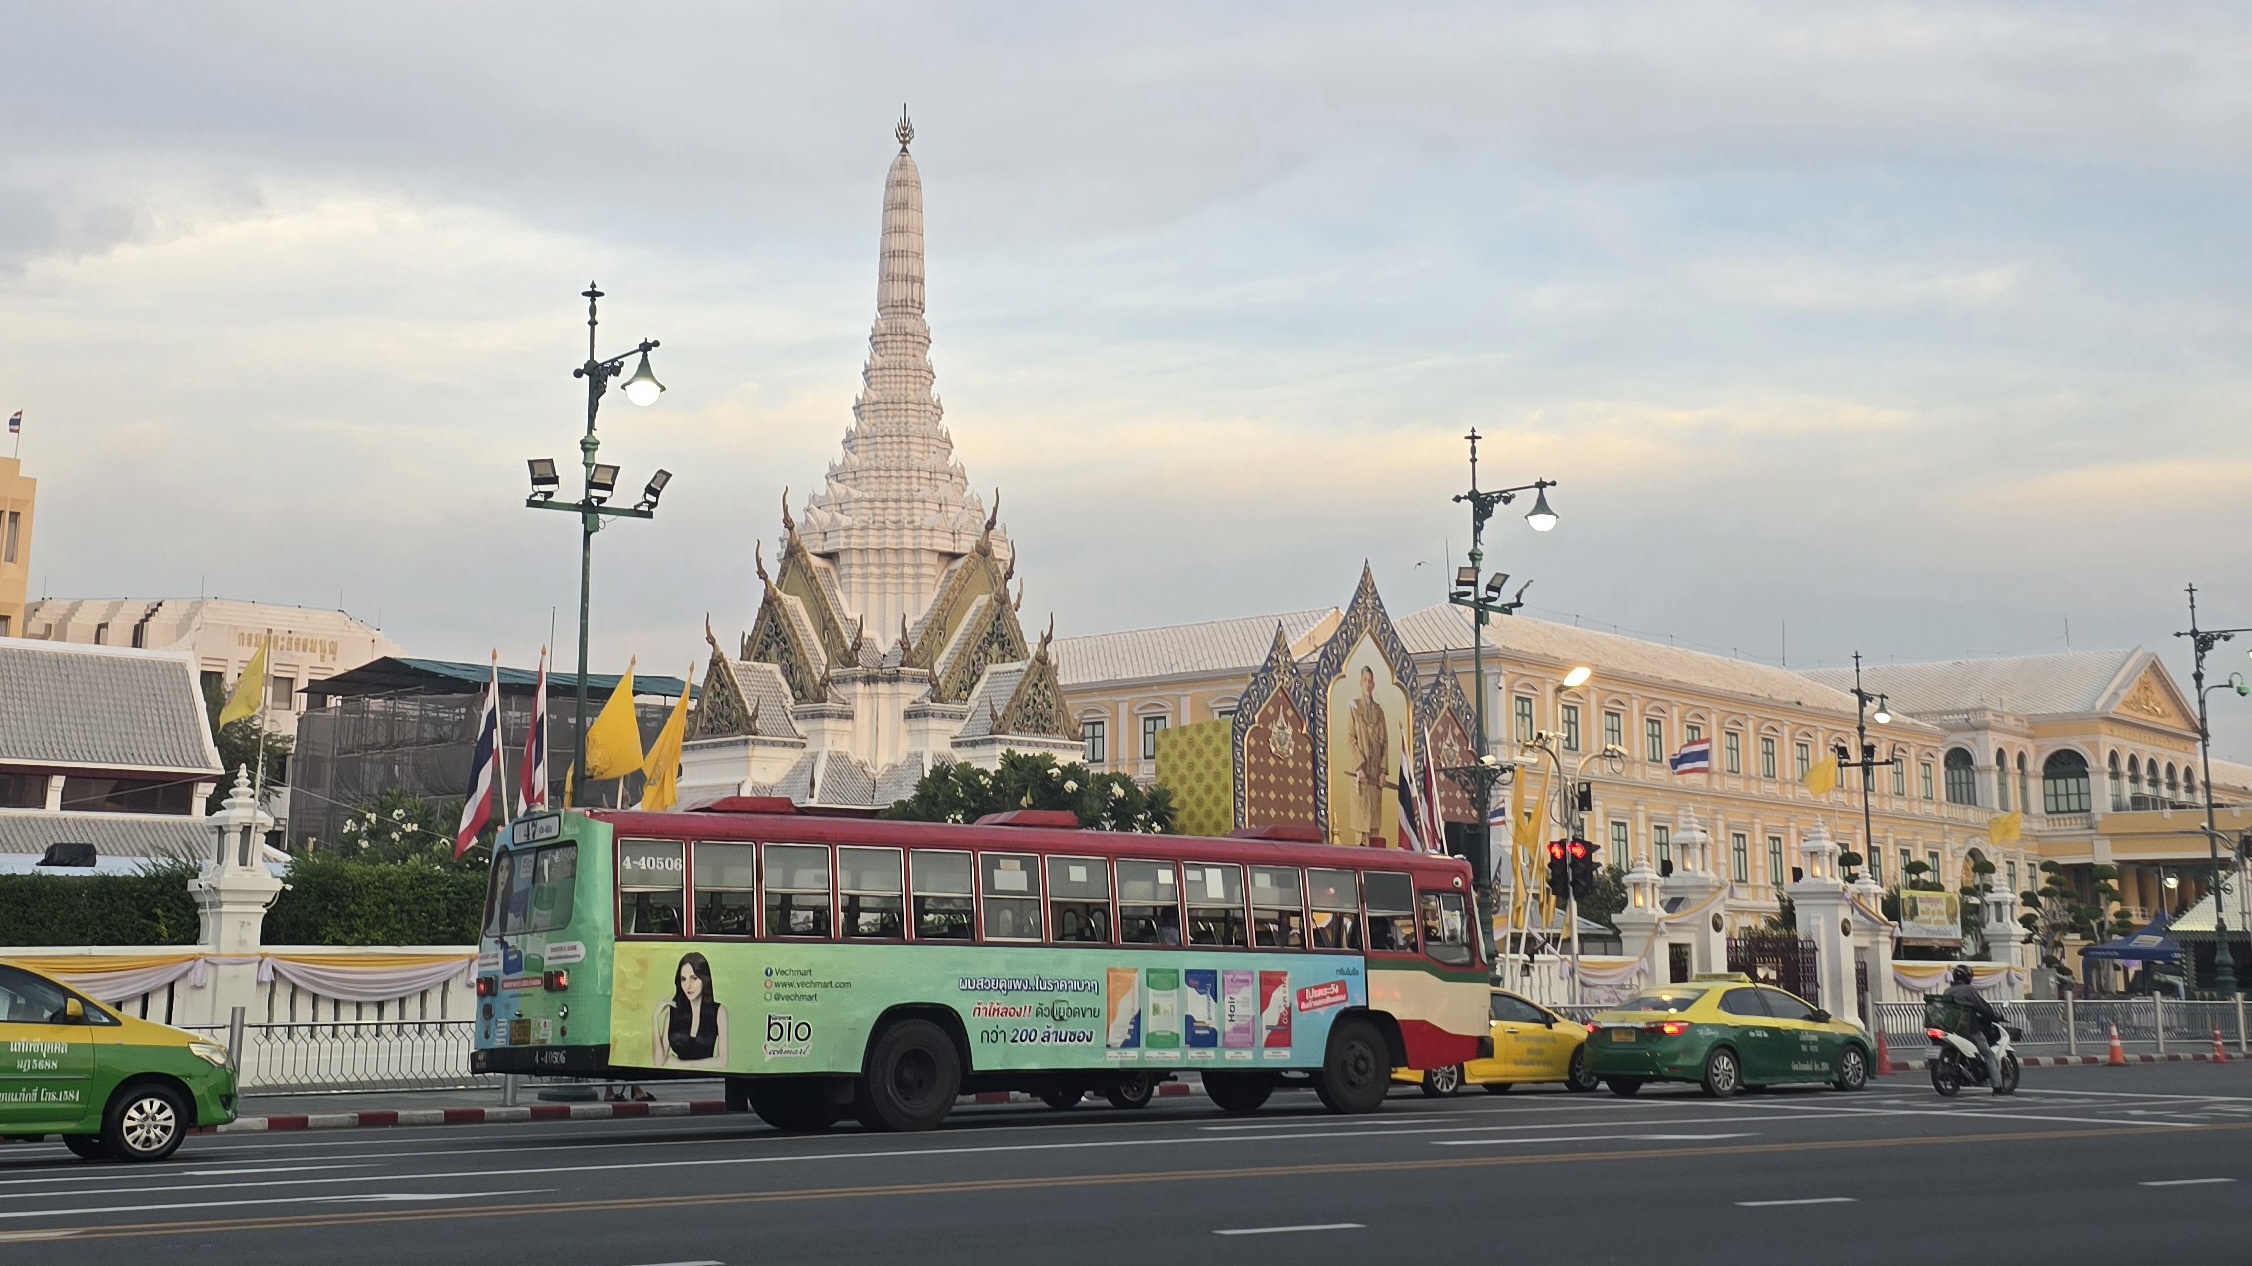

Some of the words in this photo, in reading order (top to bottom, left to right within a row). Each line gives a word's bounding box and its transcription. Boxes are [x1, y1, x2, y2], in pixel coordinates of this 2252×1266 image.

[623, 856, 683, 871] 4-40506
[775, 967, 812, 977] Vechmart
[774, 980, 852, 989] www.vechmart.com
[774, 992, 817, 1002] @vechmart
[767, 1014, 812, 1042] bio
[980, 1025, 1006, 1044] กว่า
[1010, 1028, 1038, 1043] 200
[1041, 1025, 1094, 1043] ล้านซอง
